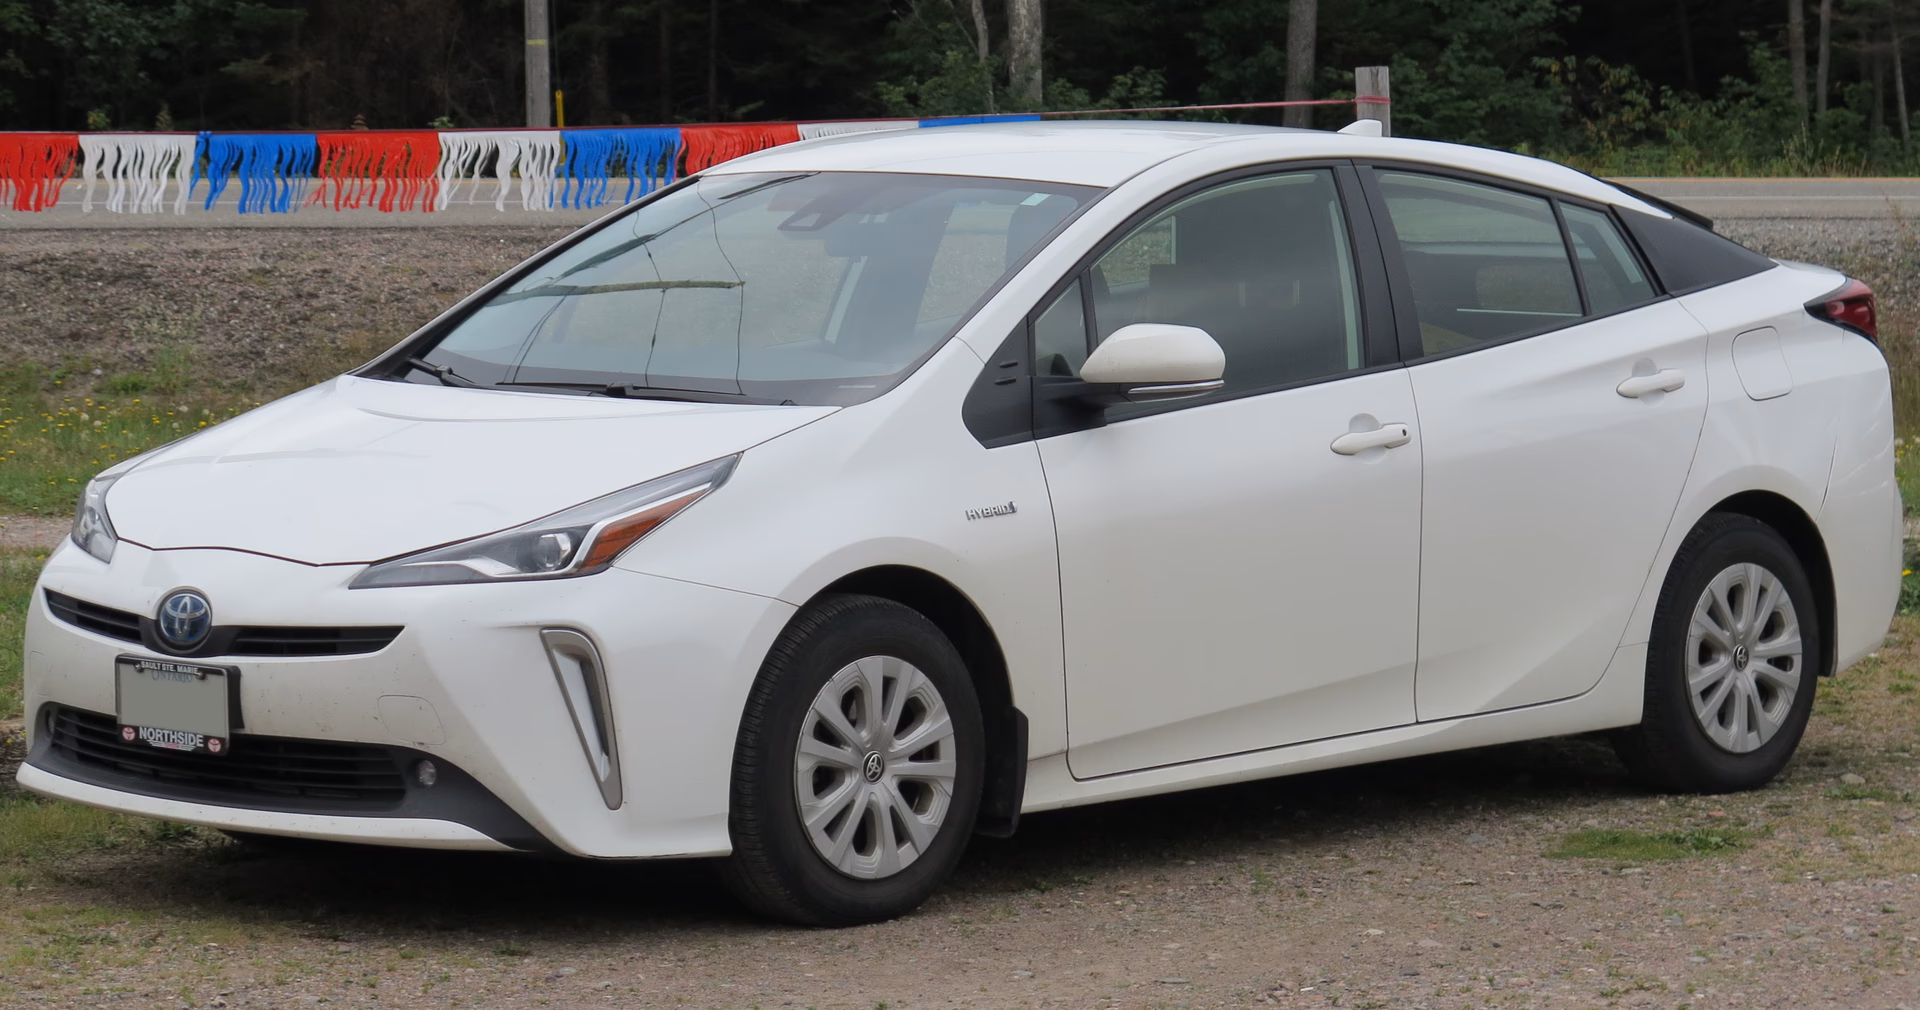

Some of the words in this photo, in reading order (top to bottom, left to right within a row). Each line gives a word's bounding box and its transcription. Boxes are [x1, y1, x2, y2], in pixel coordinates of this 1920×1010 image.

[965, 504, 1009, 520] HYBRID
[141, 661, 160, 669] SAULT
[162, 663, 176, 671] STE.
[177, 665, 198, 674] MARIE
[139, 726, 204, 747] NORTHSIDE
